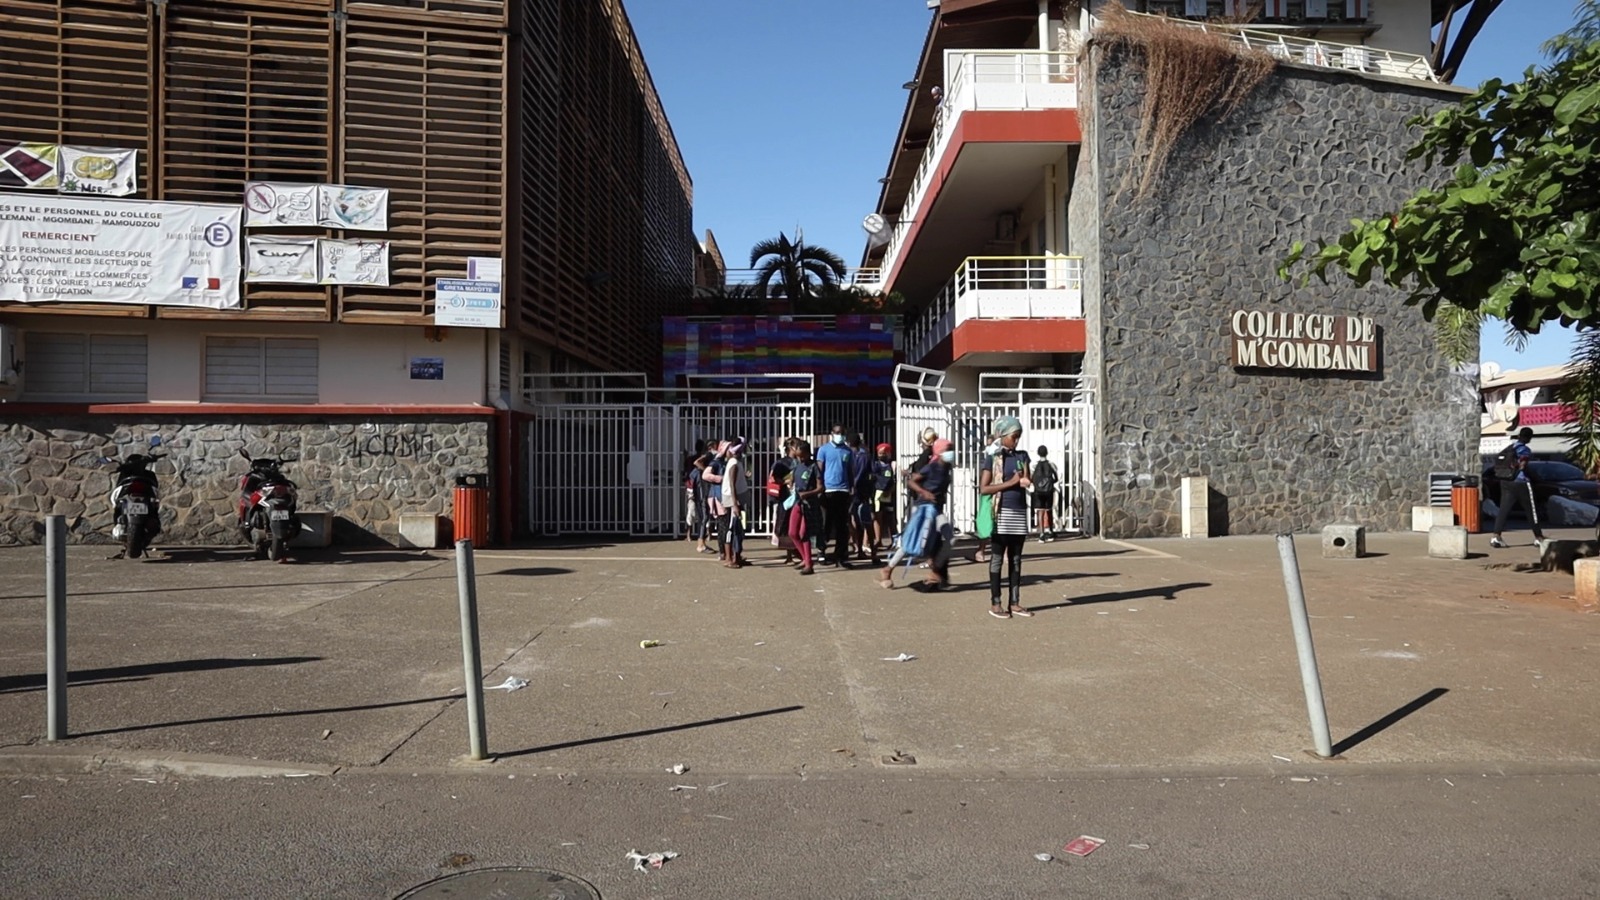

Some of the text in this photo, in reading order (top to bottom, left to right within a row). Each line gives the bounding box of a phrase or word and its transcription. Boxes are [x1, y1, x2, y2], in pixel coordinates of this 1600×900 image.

[14, 205, 26, 213] ET
[29, 206, 41, 214] LE
[44, 207, 101, 216] PERSONNEL
[43, 215, 94, 225] MGOMBANI
[102, 218, 160, 228] MAMOUDZOU
[22, 231, 97, 242] REMERCIENT
[19, 246, 73, 255] PERSONNES
[75, 248, 126, 257] MOBILISÉES
[128, 250, 152, 259] POUR
[7, 254, 18, 262] LA
[20, 255, 72, 264] CONTINUITÉ
[75, 257, 91, 265] DES
[94, 259, 138, 267] SECTEURS
[140, 260, 152, 268] DE
[75, 270, 91, 278] LES
[93, 271, 148, 280] COMMERCES
[23, 285, 34, 293] ET
[55, 279, 89, 287] VOIRIES
[97, 280, 113, 288] LES
[1232, 310, 1375, 342] COLLEGE DE
[1237, 338, 1369, 371] M'GOMBANI
